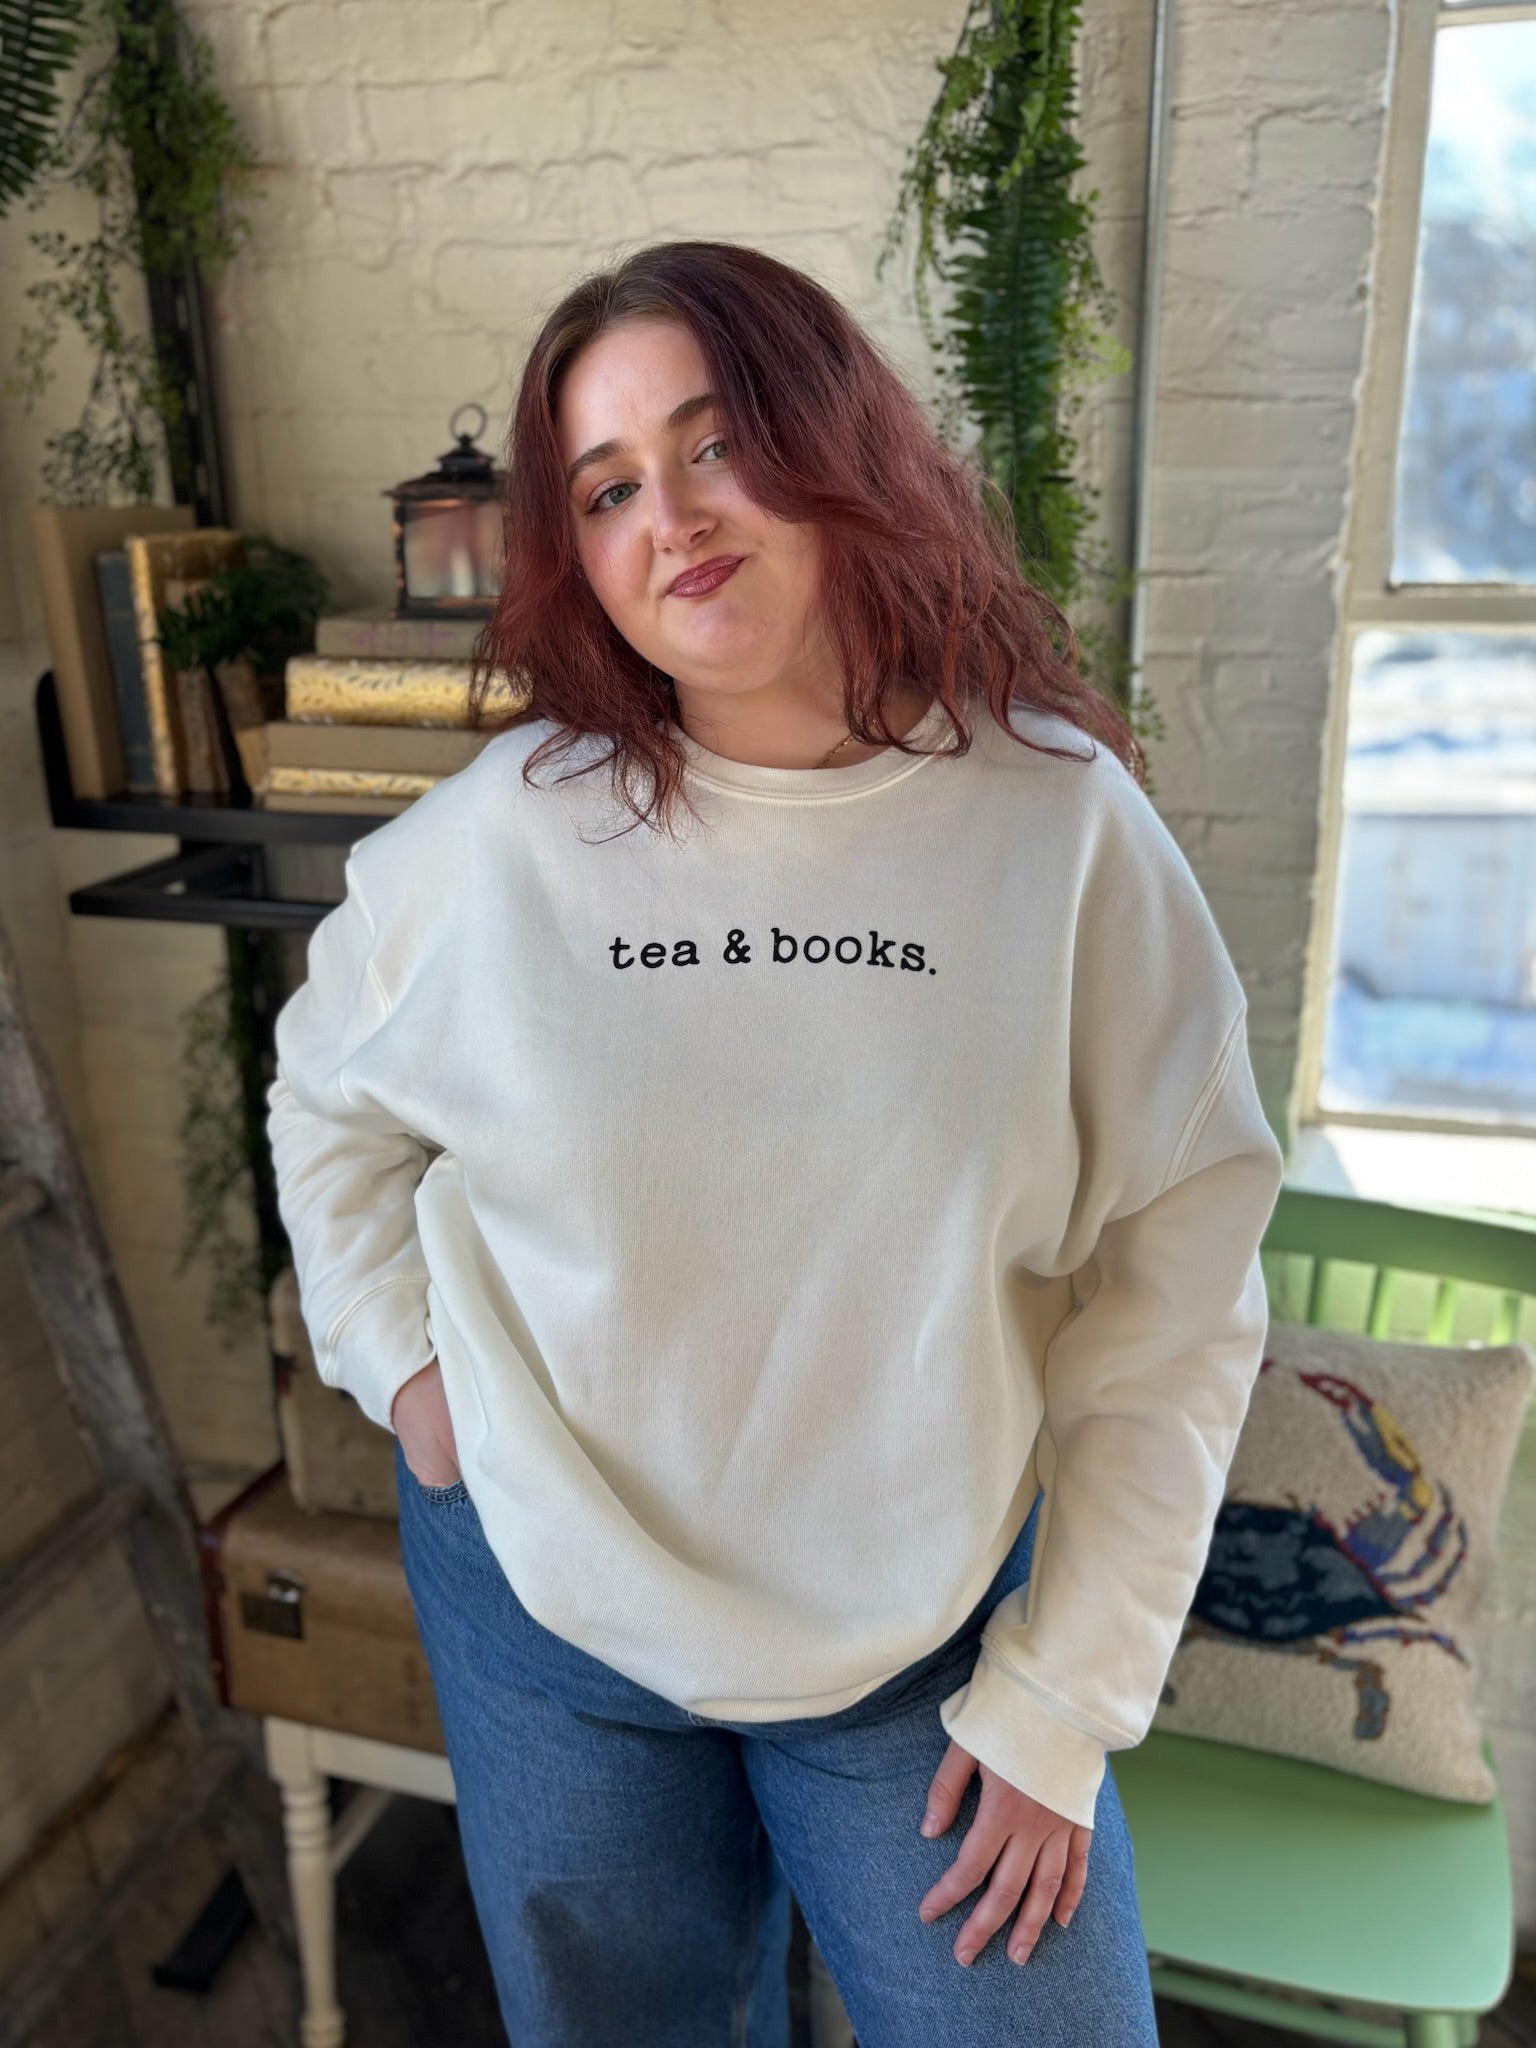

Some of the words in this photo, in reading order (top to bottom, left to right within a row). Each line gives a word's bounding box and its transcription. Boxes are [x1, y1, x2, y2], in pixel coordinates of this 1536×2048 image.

[608, 936, 700, 970] tea
[722, 928, 752, 965] &
[770, 927, 937, 976] books.
